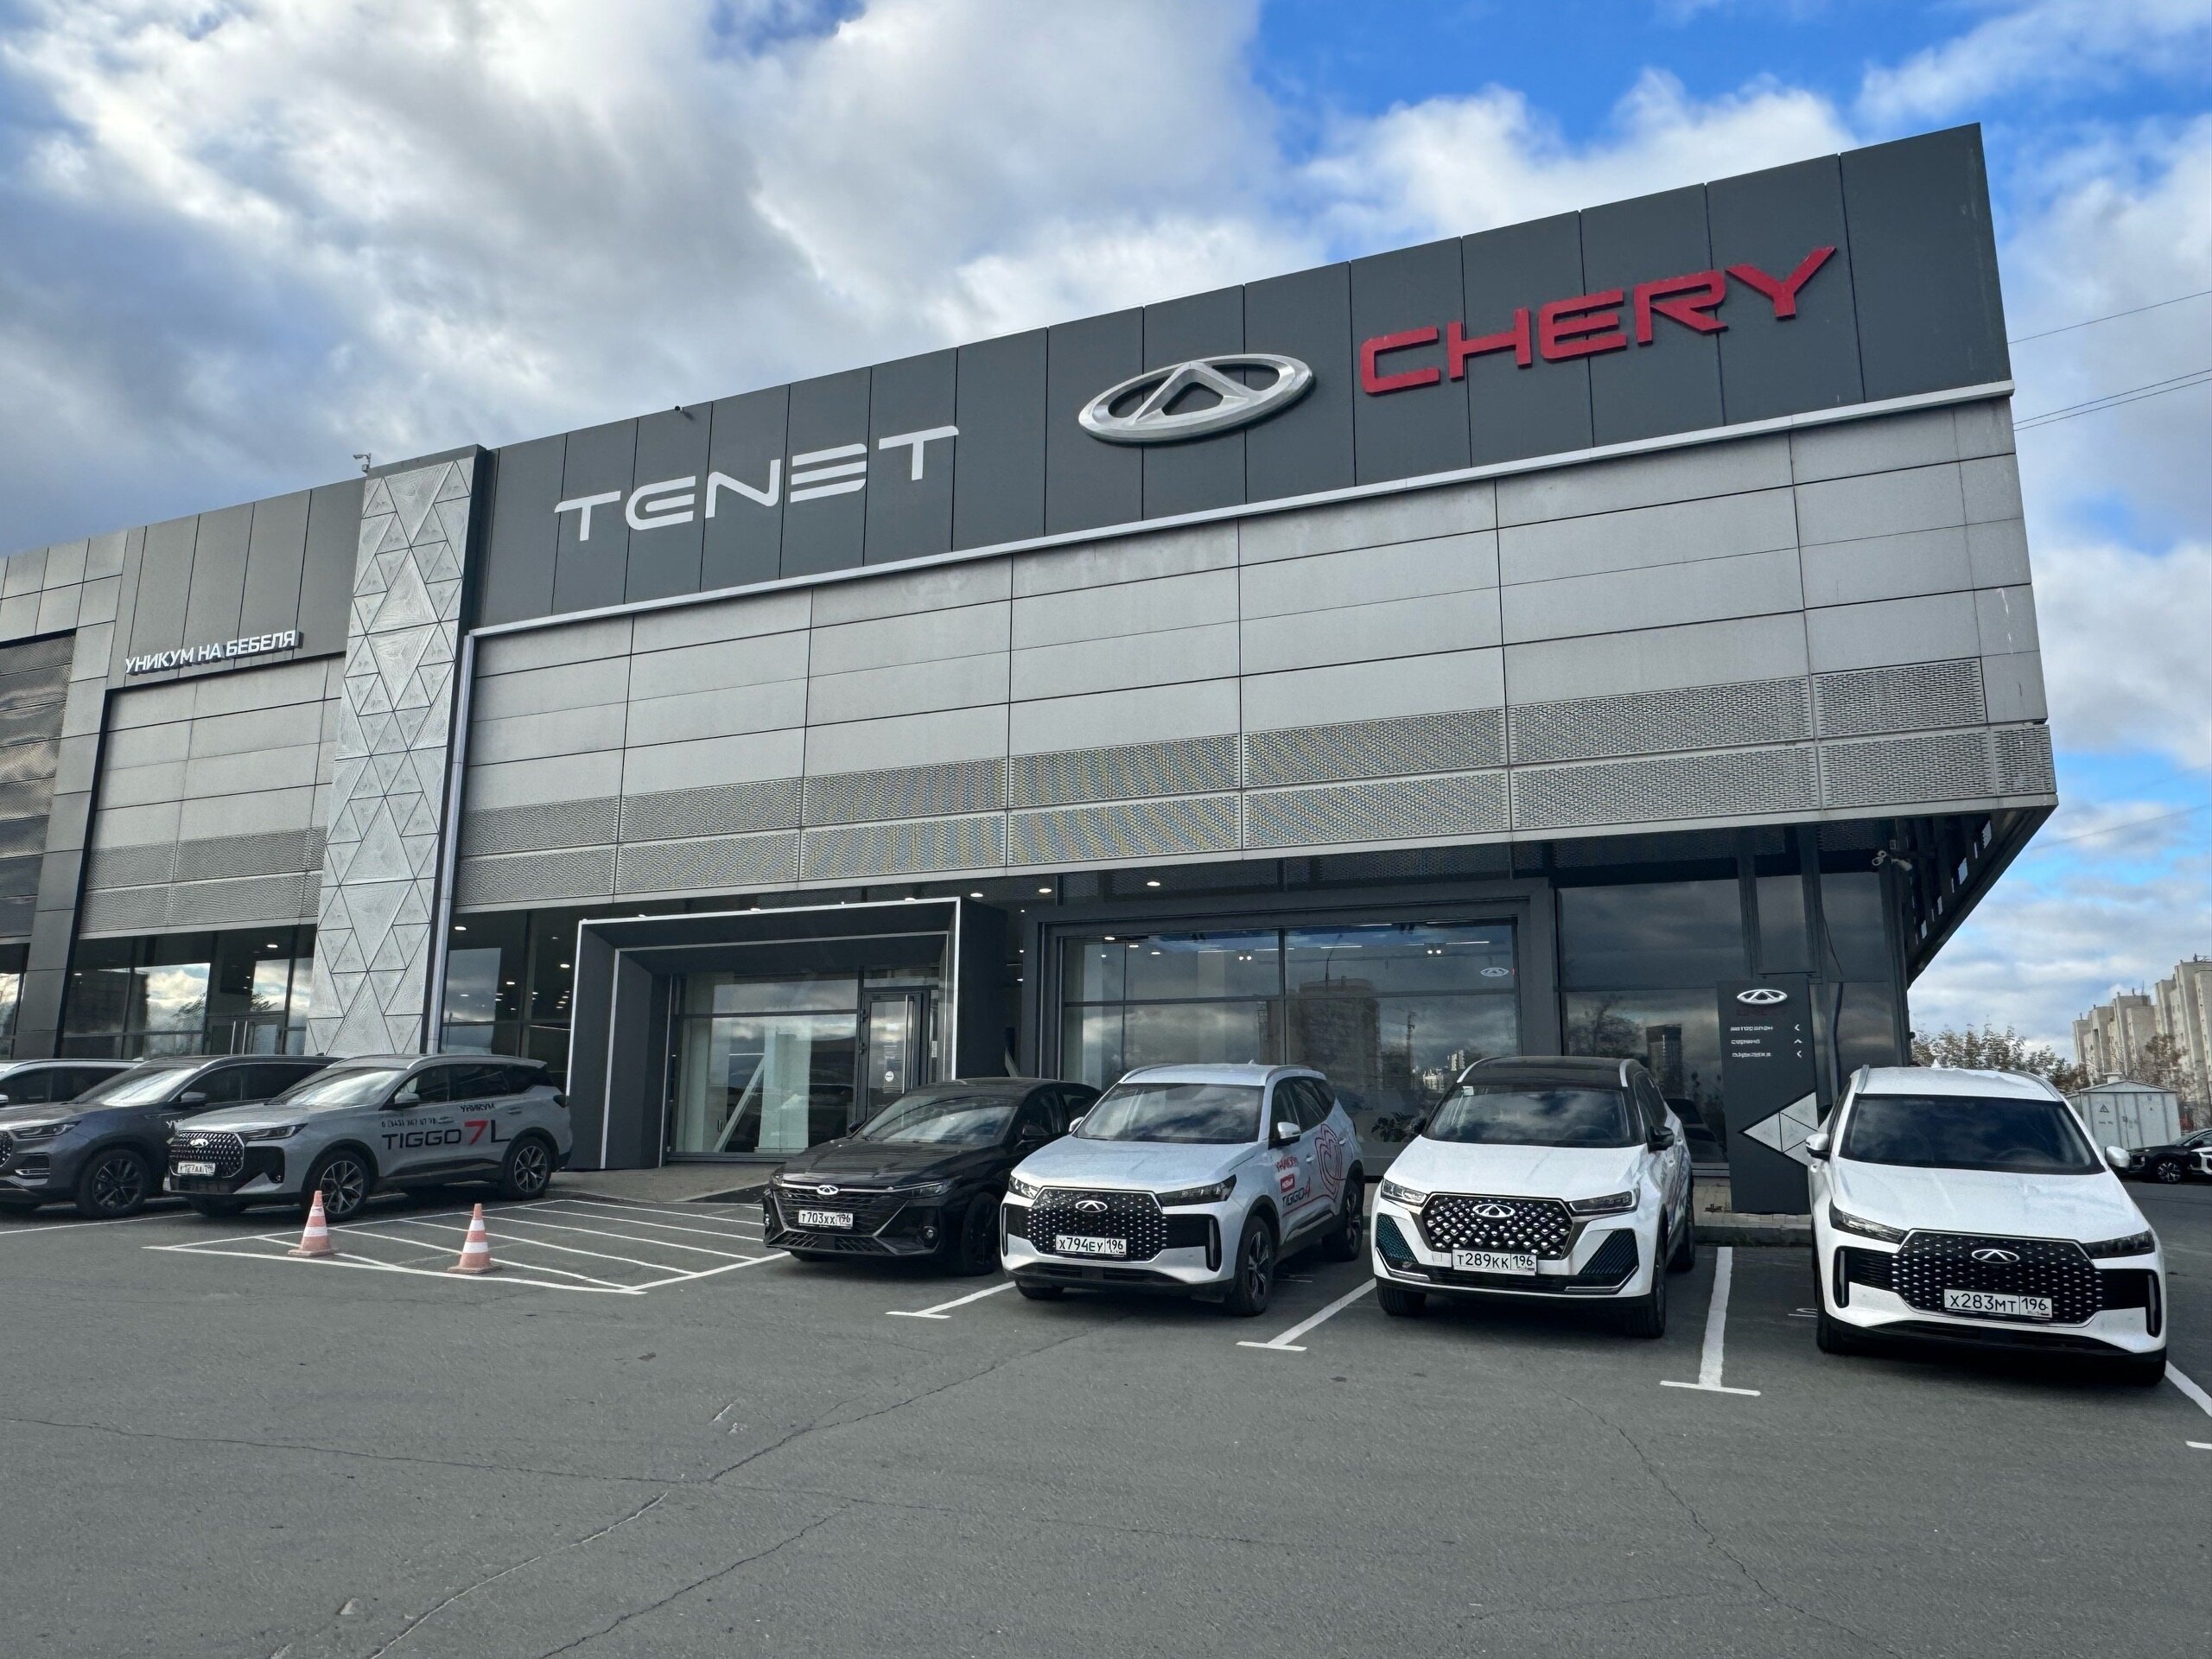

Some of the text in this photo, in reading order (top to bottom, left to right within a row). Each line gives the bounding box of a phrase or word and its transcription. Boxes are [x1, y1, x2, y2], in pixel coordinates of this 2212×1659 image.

[1360, 246, 1837, 396] CHERY
[554, 425, 959, 541] TENET
[125, 629, 299, 674] УНИКУМ НА БЕБЕЛЯ
[381, 1128, 461, 1150] TIGGO
[1058, 1236, 1124, 1252] Х794ЕУ 196
[1456, 1252, 1535, 1269] Т289КК 196
[1949, 1293, 2050, 1313] Х283МТ 196
